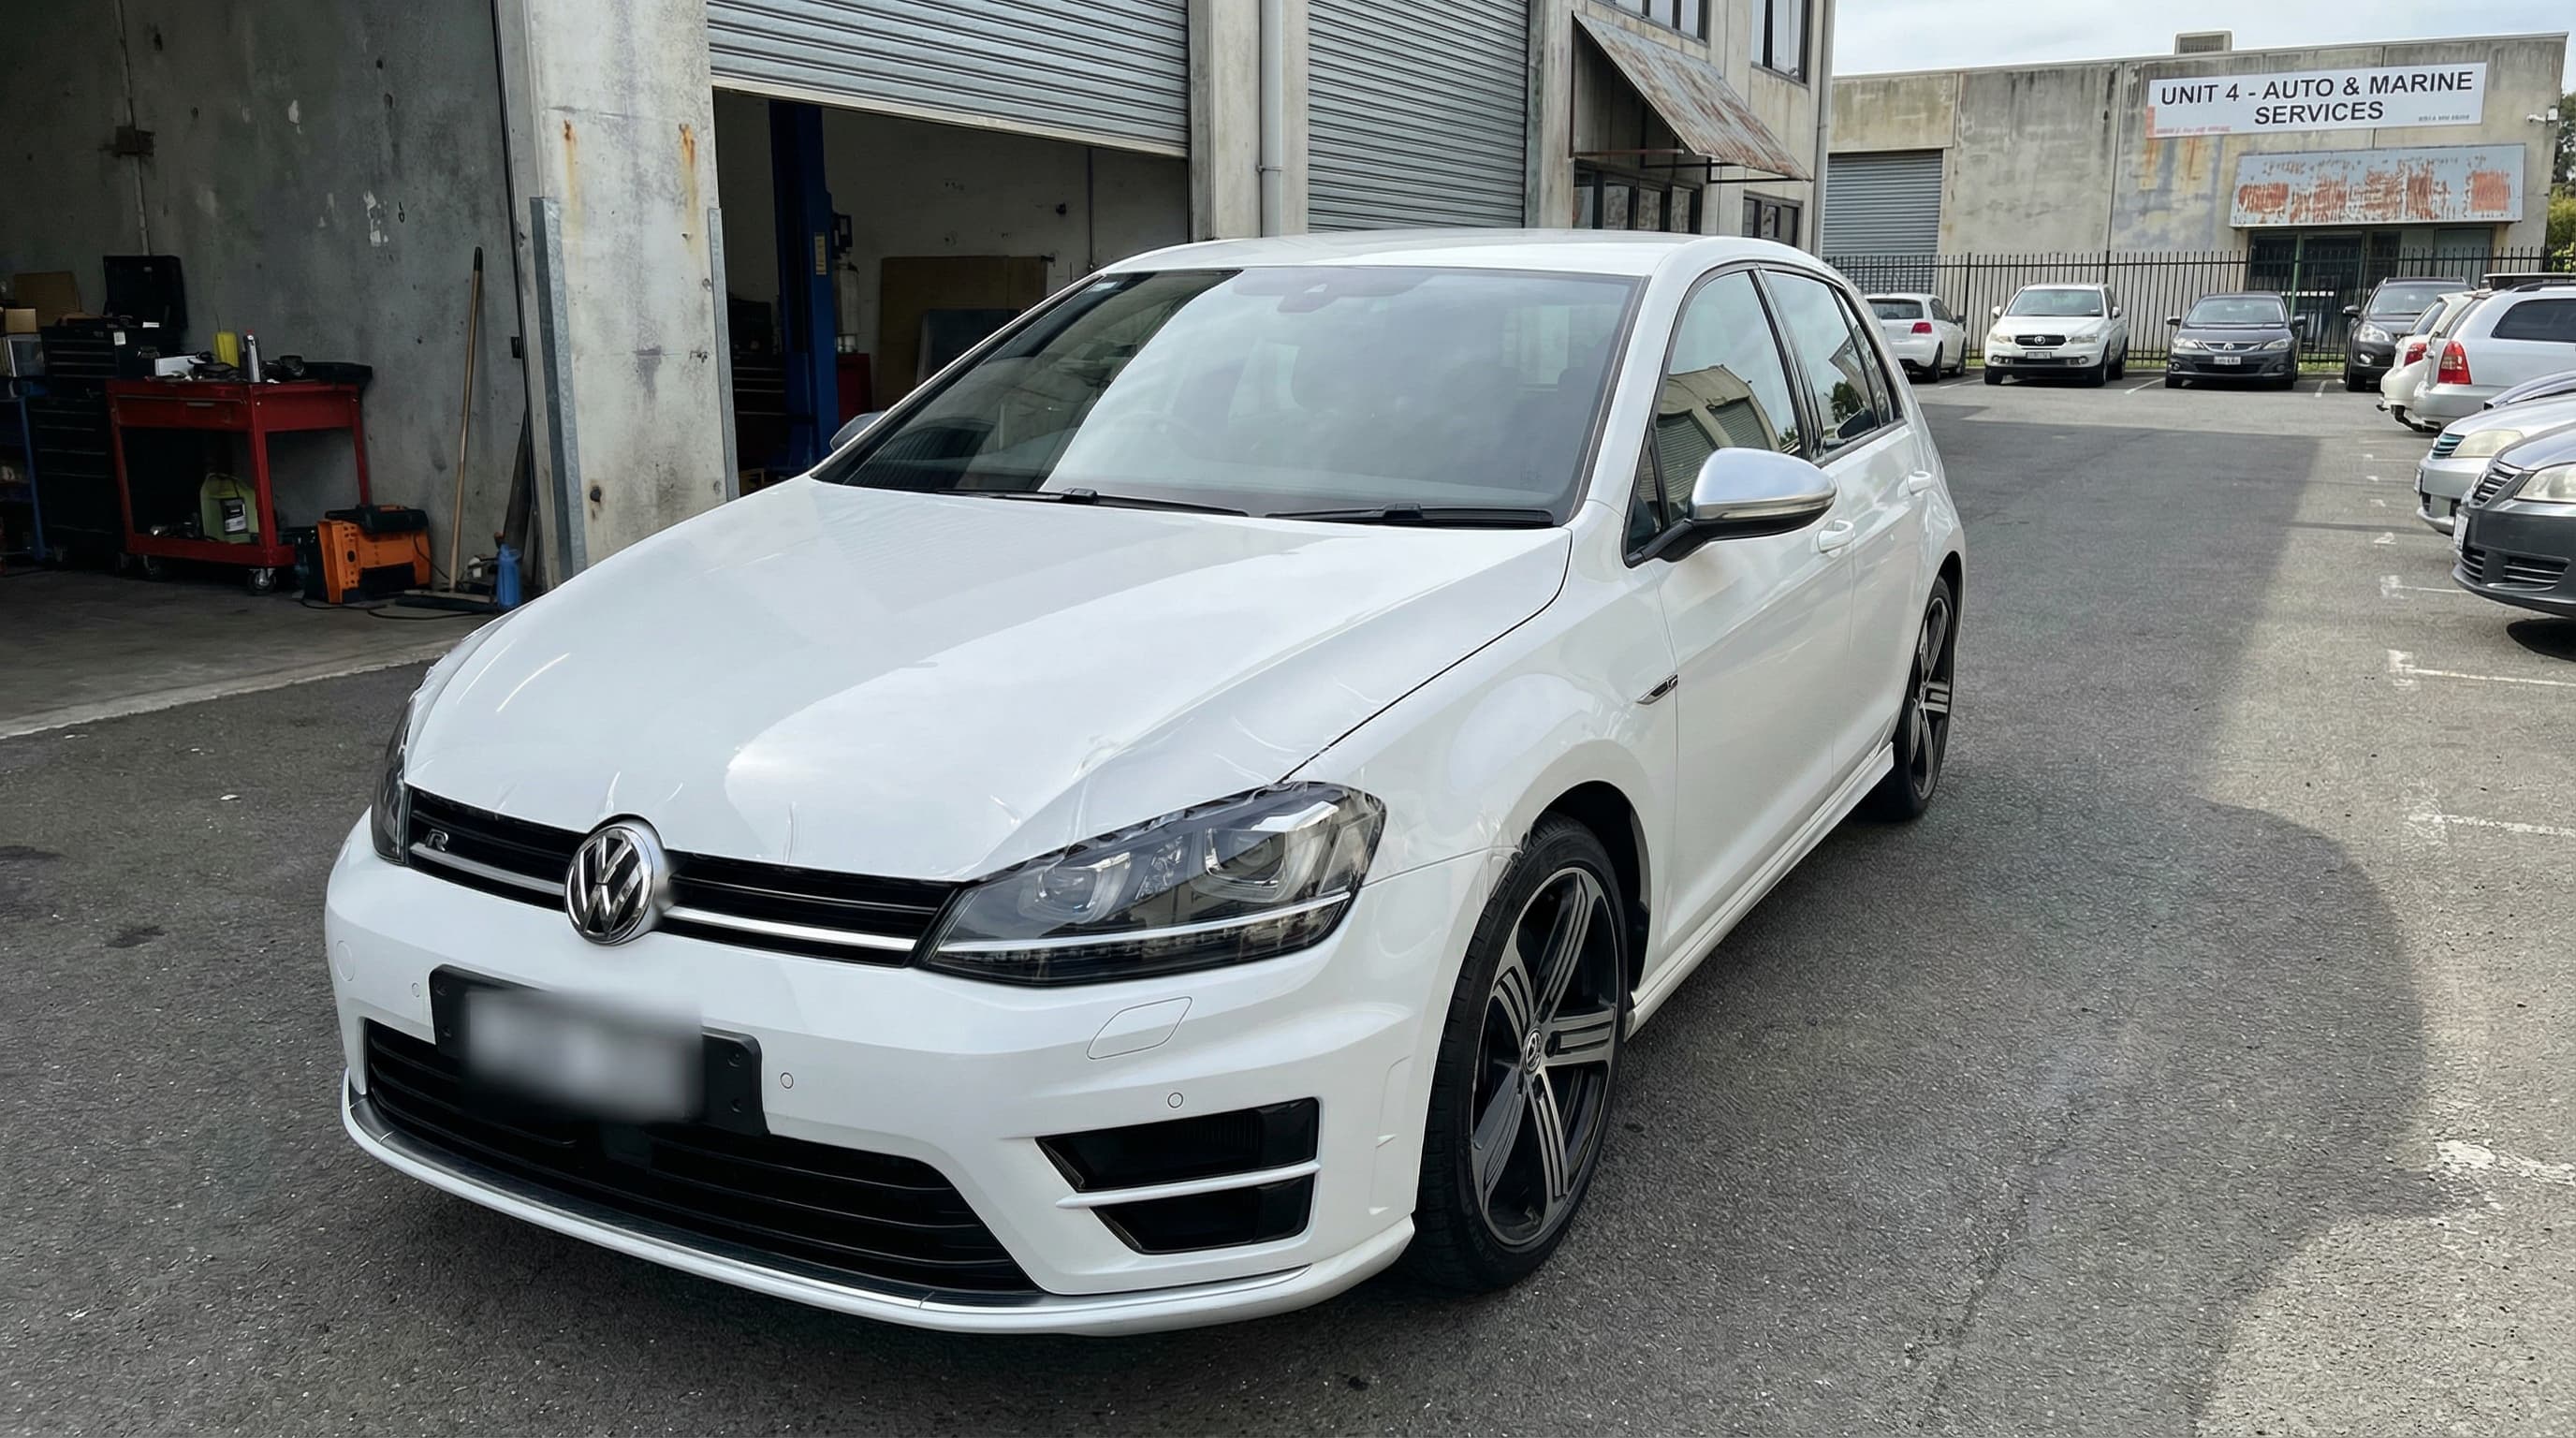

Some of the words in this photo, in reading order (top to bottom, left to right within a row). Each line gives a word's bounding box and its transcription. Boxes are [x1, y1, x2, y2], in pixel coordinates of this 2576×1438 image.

[2160, 83, 2218, 106] UNIT
[2225, 82, 2240, 102] 4
[2261, 78, 2334, 100] AUTO
[2342, 77, 2360, 96] &
[2368, 71, 2474, 95] MARINE
[2254, 100, 2384, 125] SERVICES
